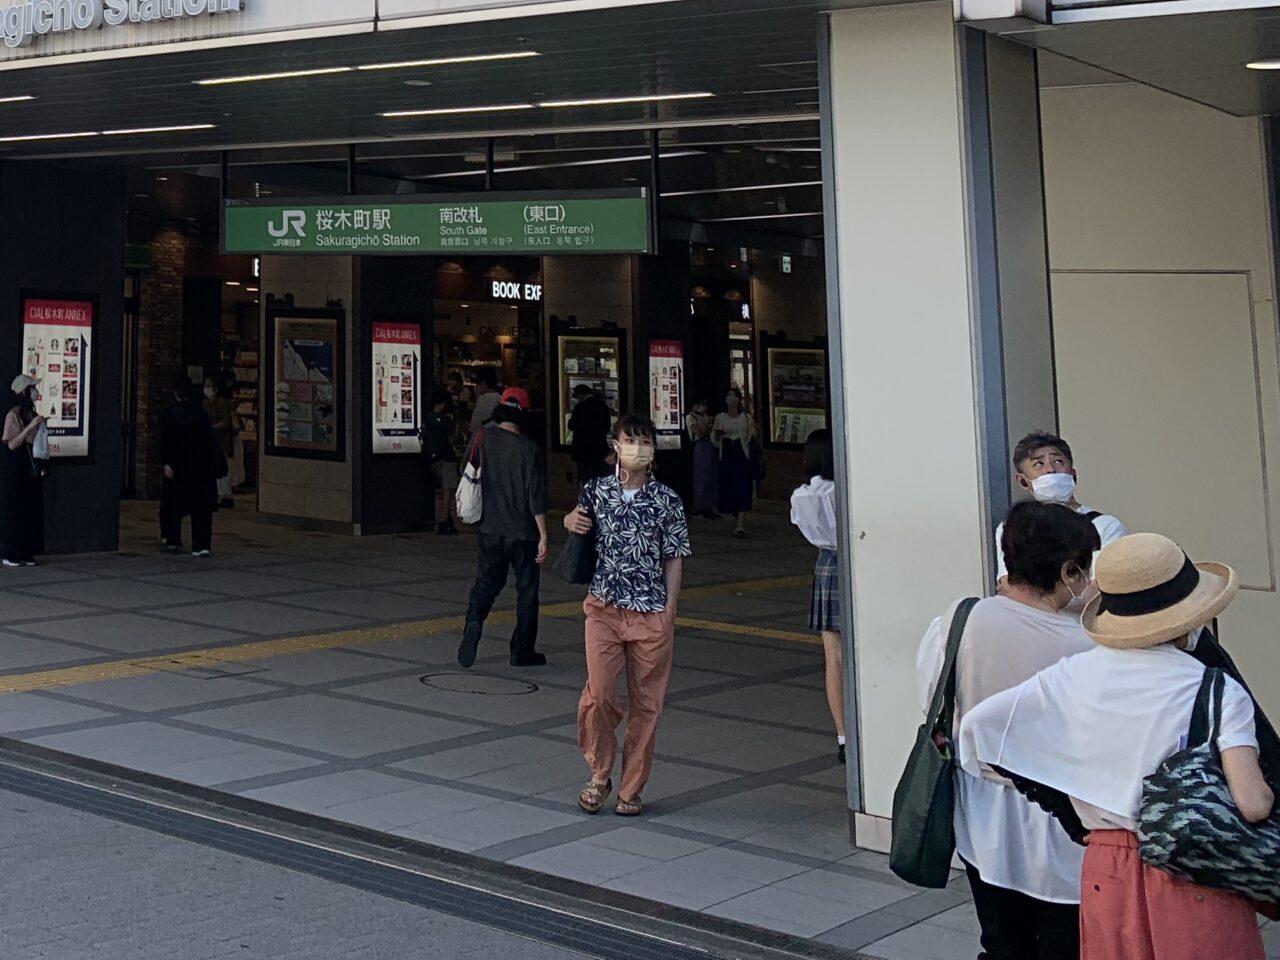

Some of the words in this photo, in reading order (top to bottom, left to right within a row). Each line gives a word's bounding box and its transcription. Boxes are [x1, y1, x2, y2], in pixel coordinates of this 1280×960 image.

[268, 210, 306, 238] JR
[316, 208, 391, 231] 桜木町駅
[439, 206, 483, 224] 南改札
[440, 226, 464, 235] South
[466, 225, 488, 235] Gate
[523, 224, 548, 234] (East
[550, 223, 594, 235] Entrance)
[382, 232, 421, 247] Station
[491, 280, 522, 300] BOOK
